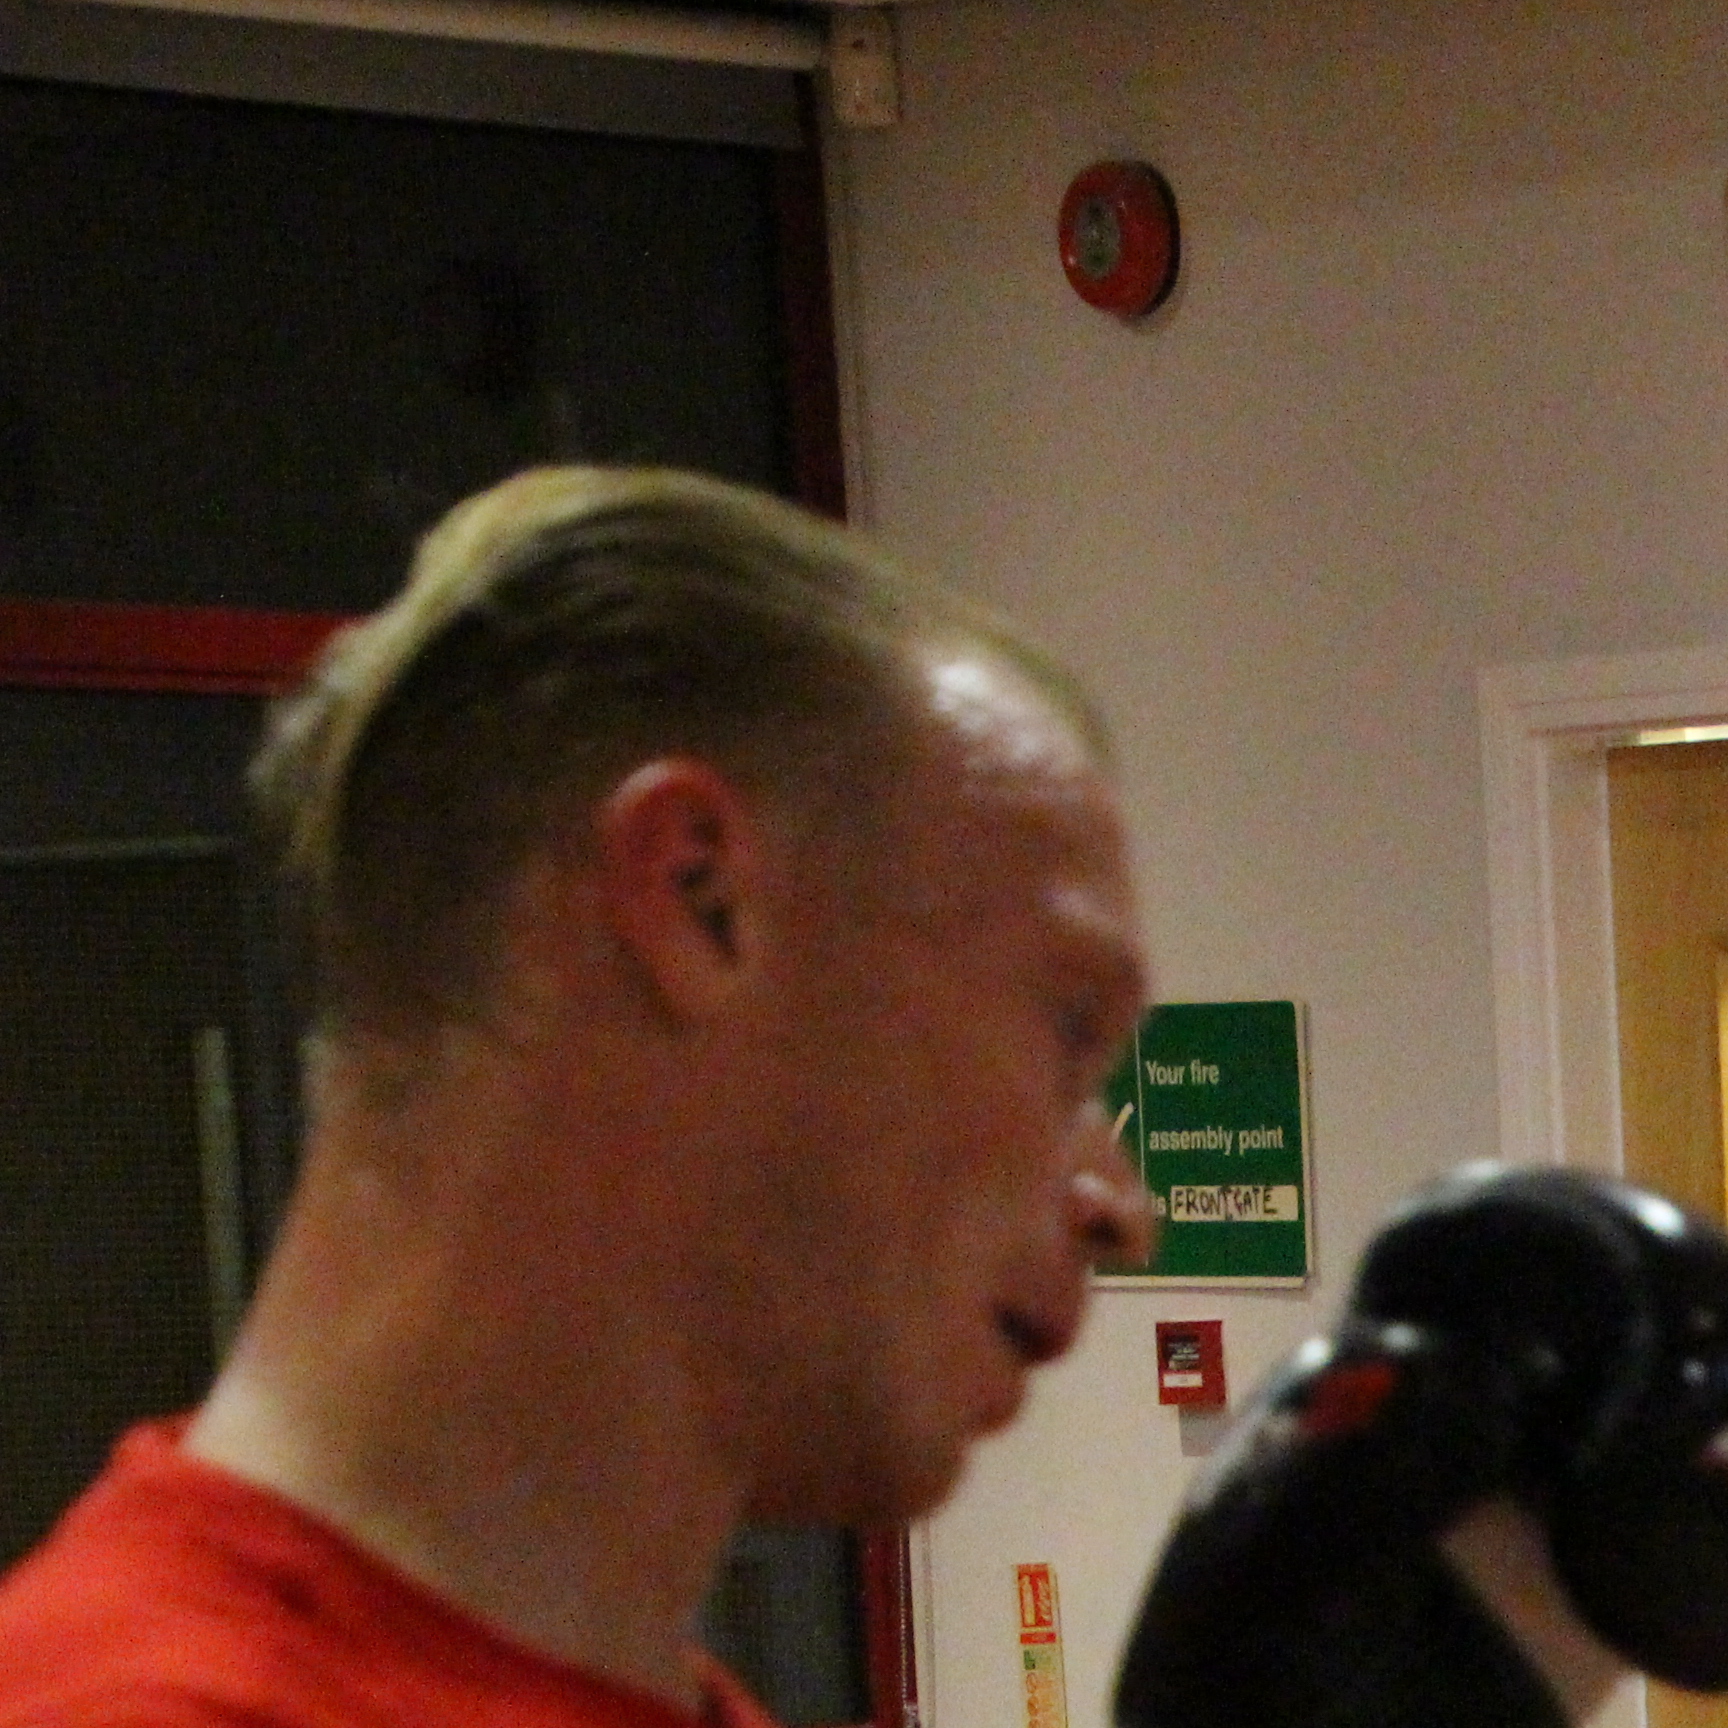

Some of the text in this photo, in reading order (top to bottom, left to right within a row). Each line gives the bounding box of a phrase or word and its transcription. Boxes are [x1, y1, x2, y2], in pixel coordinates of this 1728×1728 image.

[1146, 1059, 1219, 1085] Your fire
[1150, 1125, 1285, 1157] assembly point
